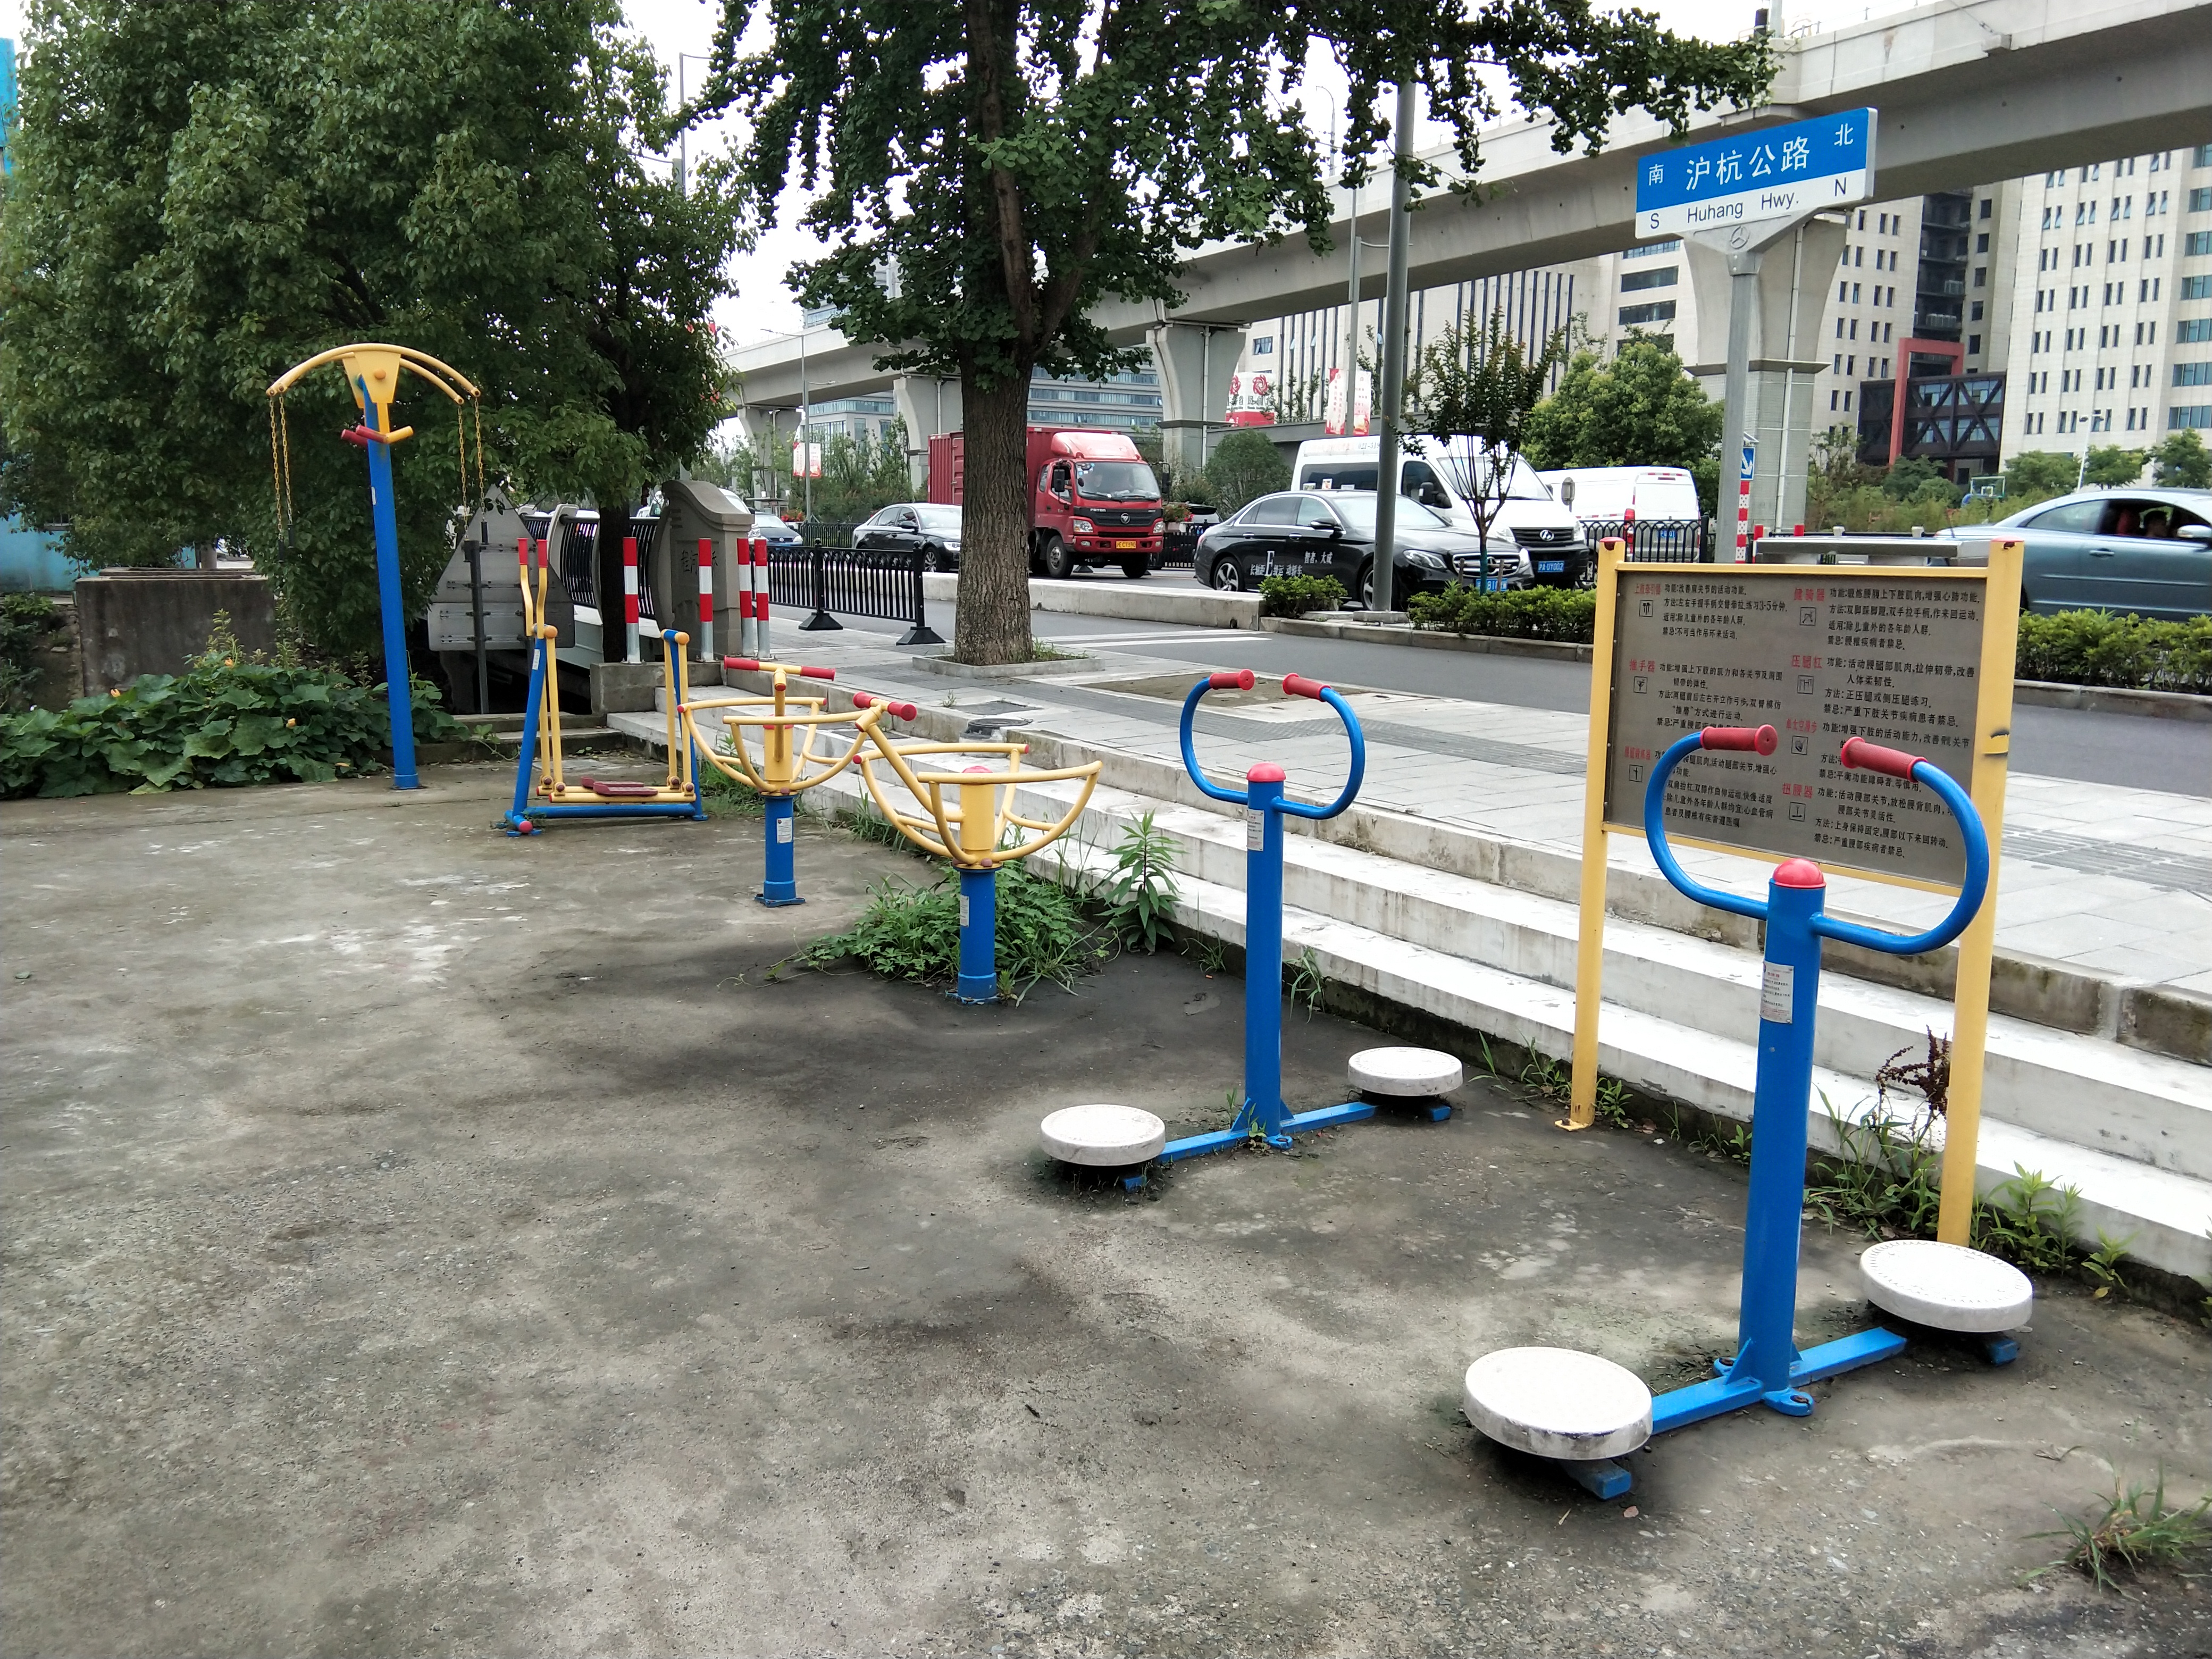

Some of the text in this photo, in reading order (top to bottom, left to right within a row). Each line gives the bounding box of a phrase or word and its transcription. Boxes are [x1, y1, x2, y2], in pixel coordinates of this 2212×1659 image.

[1648, 123, 1854, 191] 南 沪杭公路 北
[1649, 177, 1847, 229] S Huhang Hwy. N
[1794, 588, 1825, 602] 健骑器
[1629, 659, 1656, 673] 推手器
[1791, 655, 1822, 669] 压腿杠
[1782, 782, 1813, 799] 扭腰器
